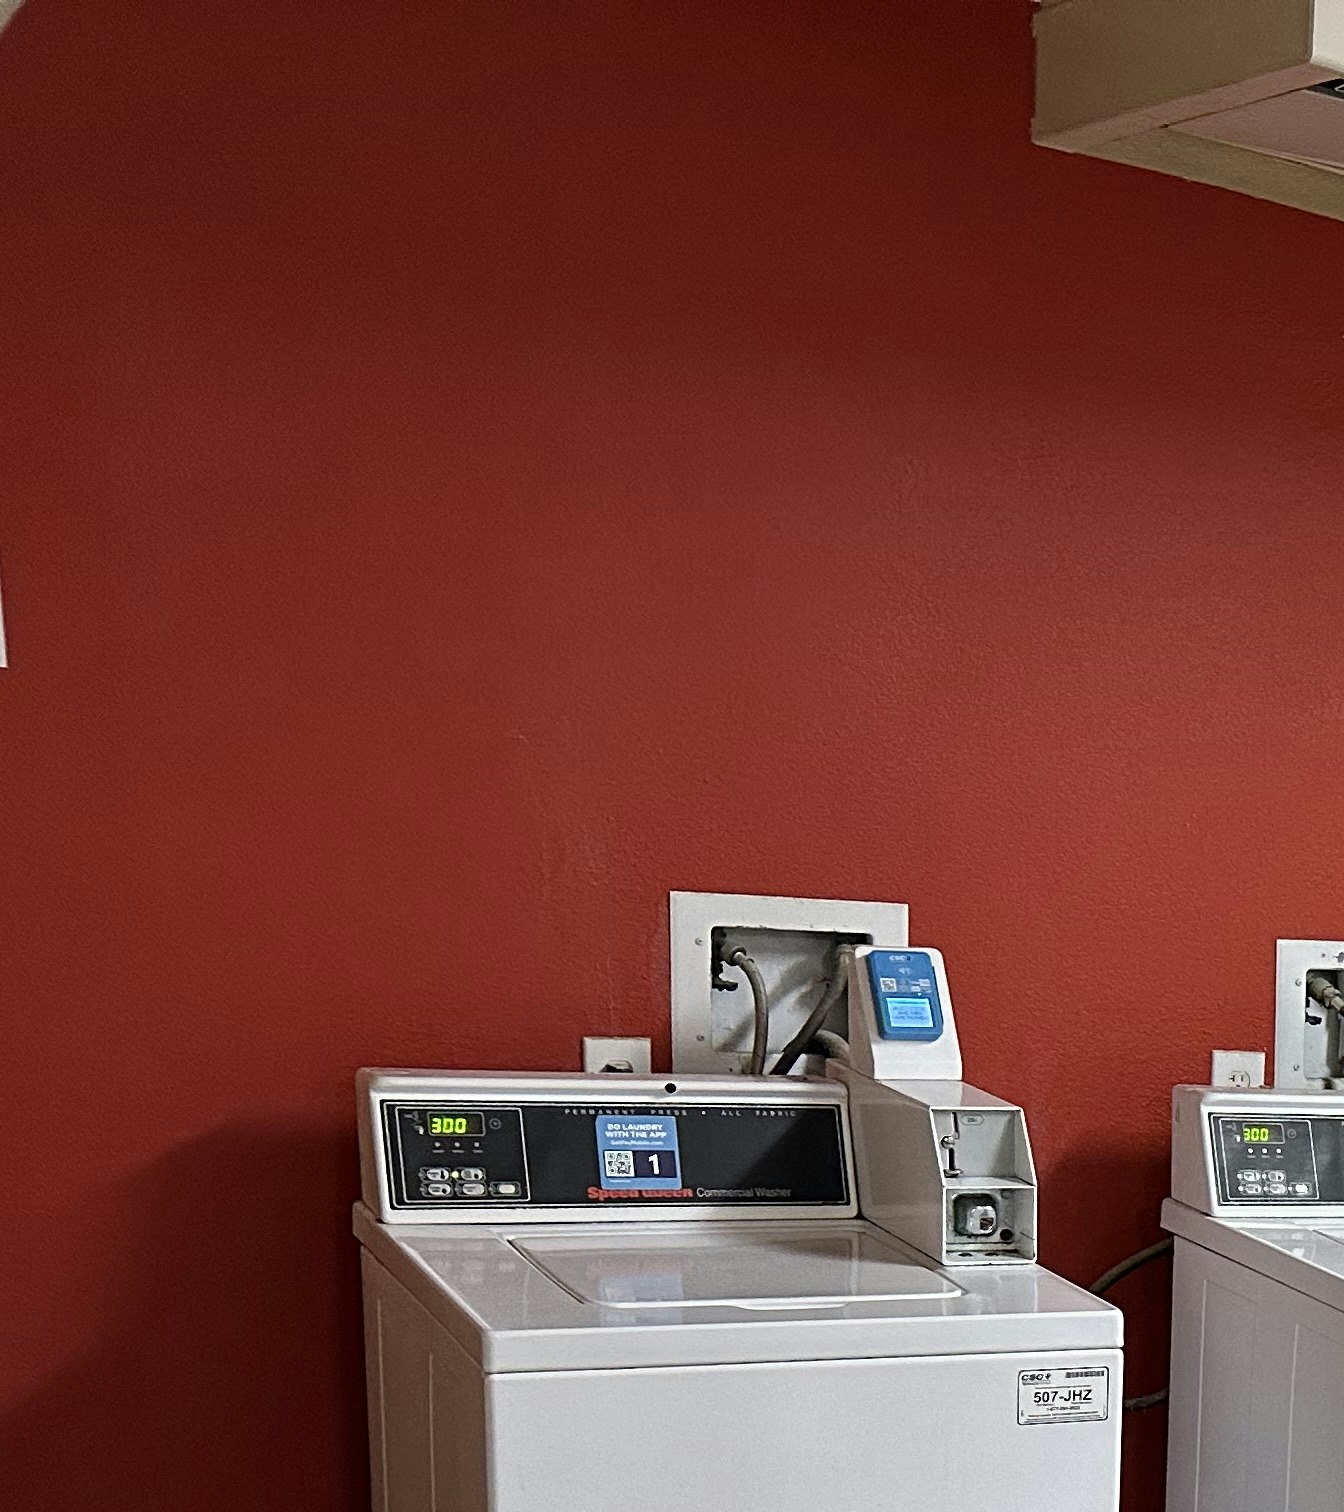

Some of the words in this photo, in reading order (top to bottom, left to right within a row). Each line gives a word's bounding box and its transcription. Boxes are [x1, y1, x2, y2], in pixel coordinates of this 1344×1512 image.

[432, 1117, 467, 1134] 300
[607, 1123, 621, 1131] DO
[622, 1123, 664, 1131] LAUNDRY
[605, 1131, 629, 1139] WITH
[630, 1131, 648, 1139] THE
[649, 1132, 668, 1140] APP
[1243, 1127, 1269, 1142] 300
[648, 1153, 660, 1175] 1
[587, 1187, 639, 1200] Speed
[696, 1187, 754, 1198] Commercial
[755, 1188, 792, 1198] Washer
[1033, 1389, 1093, 1404] 507-JHZ
